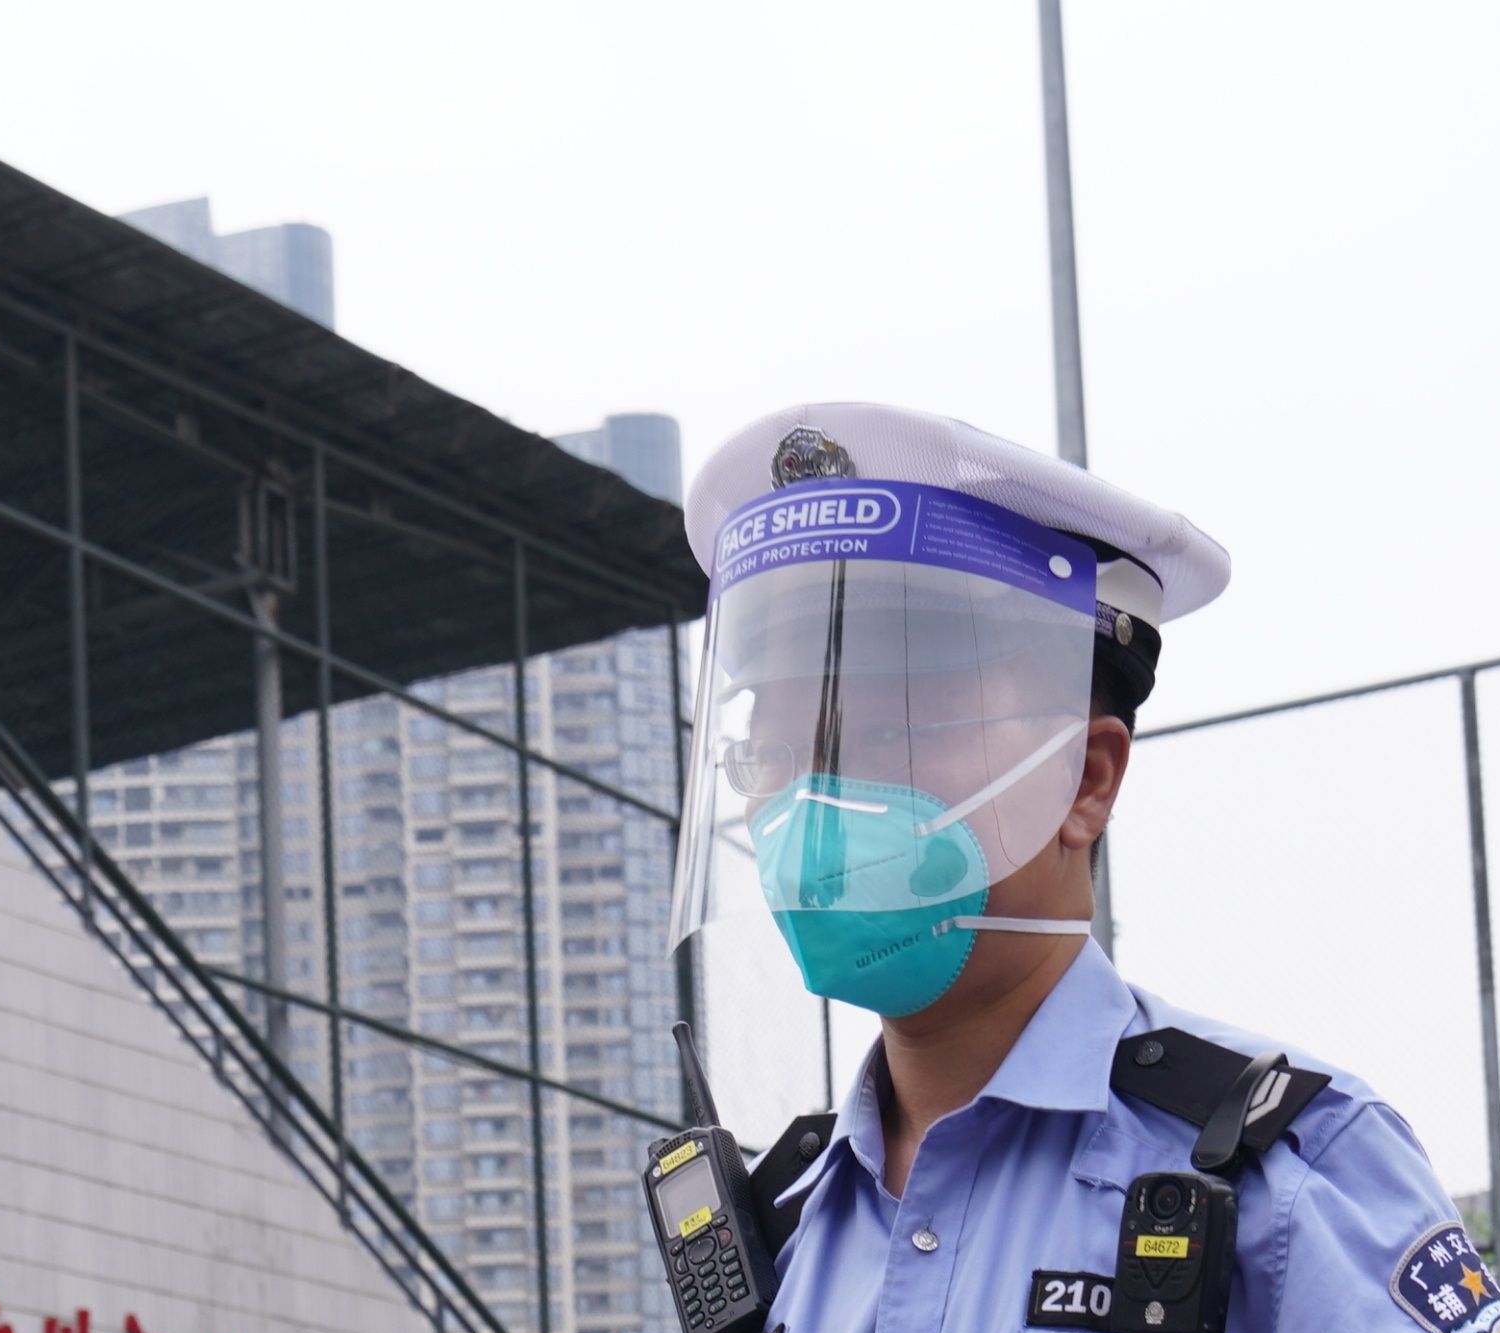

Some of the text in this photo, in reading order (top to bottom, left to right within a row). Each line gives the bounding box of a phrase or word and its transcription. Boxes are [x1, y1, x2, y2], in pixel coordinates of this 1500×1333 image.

[721, 499, 880, 561] FACE SHIELD
[720, 539, 868, 587] SPLASH PROTECTION
[856, 932, 921, 969] winner
[662, 1145, 693, 1170] 64823
[1144, 1240, 1180, 1254] 64672
[1410, 1233, 1480, 1290] 广州交
[1041, 1279, 1112, 1317] 210
[1427, 1283, 1467, 1321] 辅
